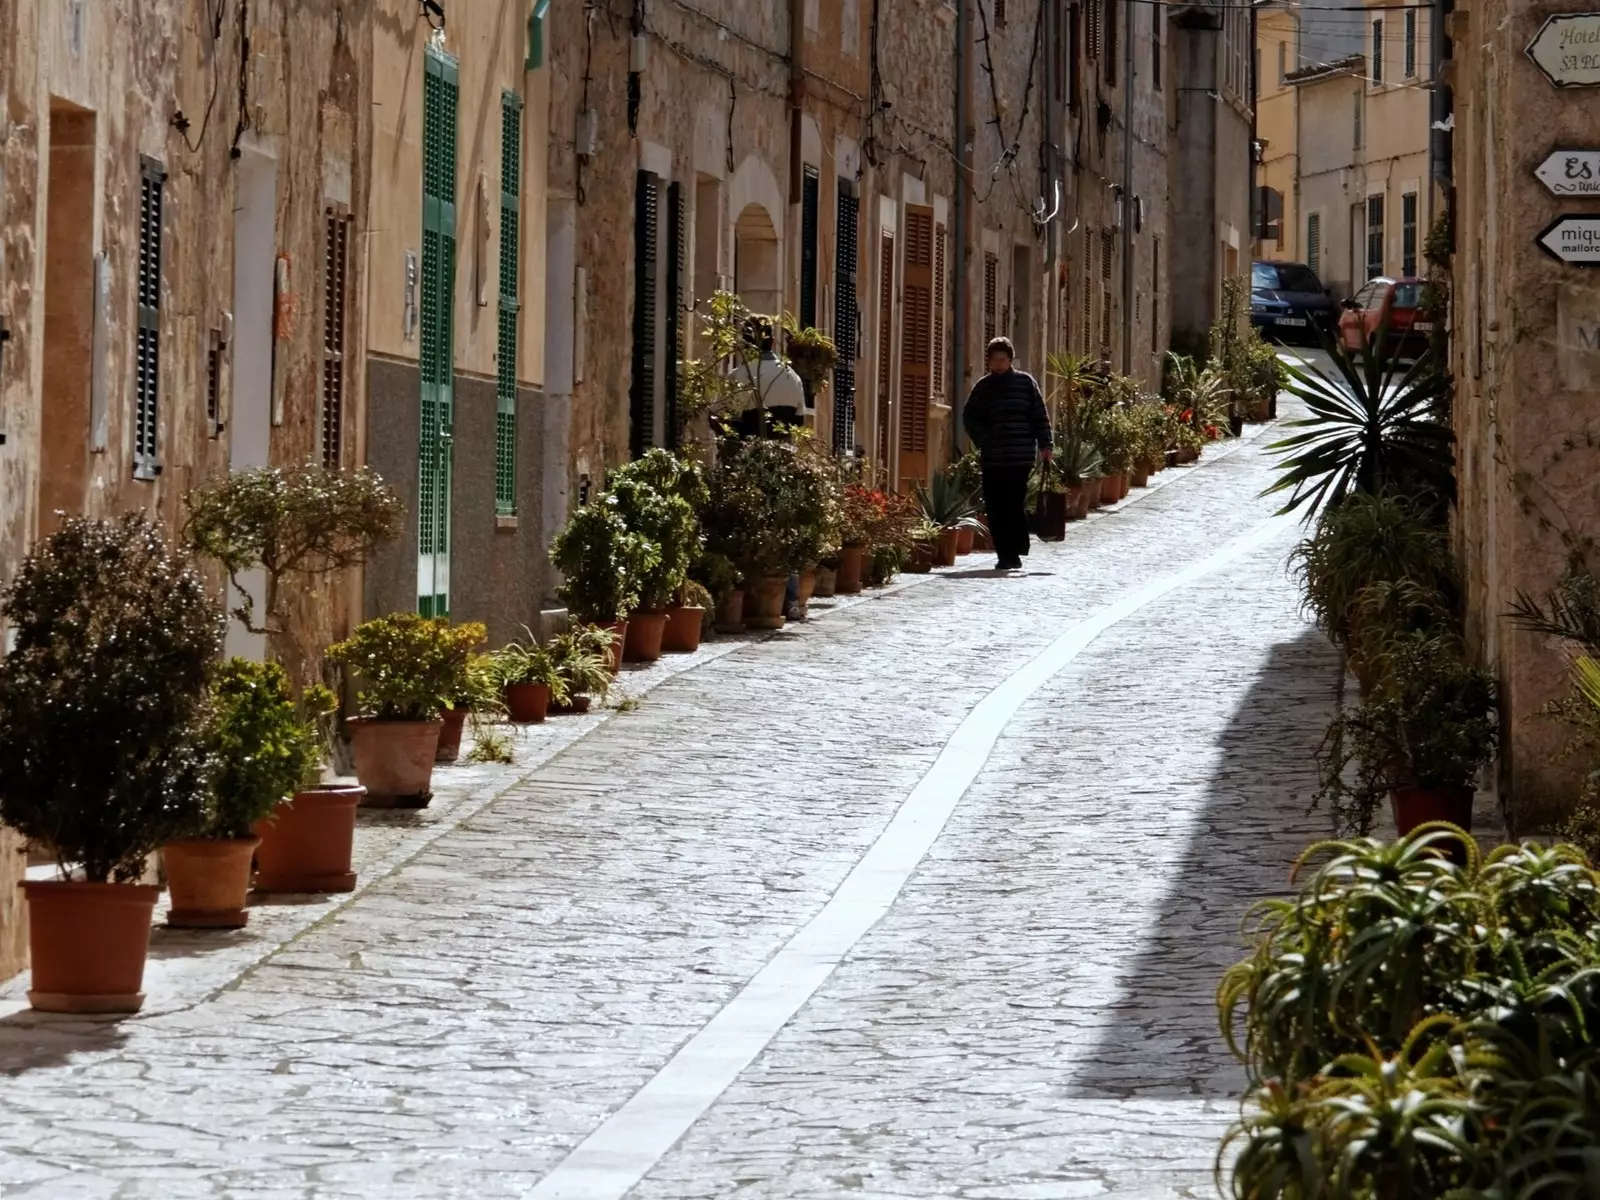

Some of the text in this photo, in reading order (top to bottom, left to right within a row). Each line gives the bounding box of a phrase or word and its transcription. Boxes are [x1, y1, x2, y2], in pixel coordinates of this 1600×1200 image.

[1560, 25, 1600, 45] Hotel
[1559, 54, 1578, 72] SA
[1565, 157, 1593, 180] Es
[1561, 227, 1600, 245] miqu
[1562, 244, 1600, 253] mallorc
